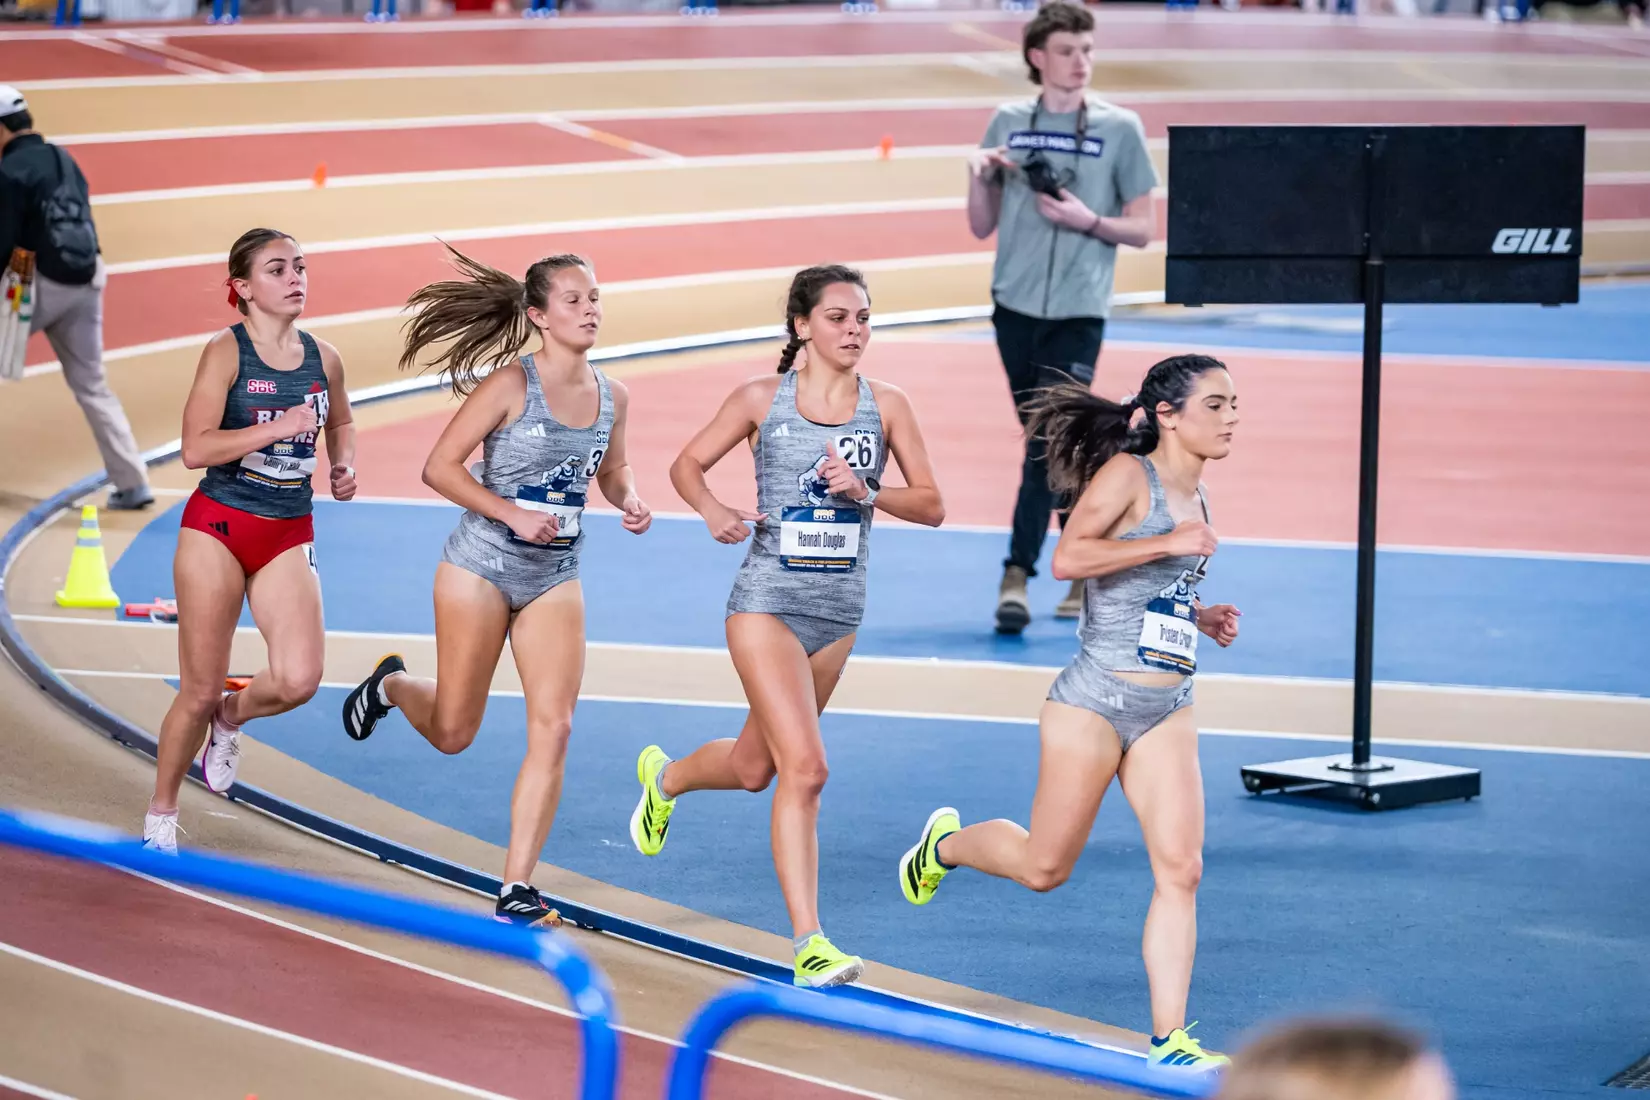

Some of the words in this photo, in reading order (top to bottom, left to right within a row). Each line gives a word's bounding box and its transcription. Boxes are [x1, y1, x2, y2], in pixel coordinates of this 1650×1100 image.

[1491, 228, 1572, 253] GILL
[247, 379, 277, 394] SBC
[273, 443, 294, 455] SBC
[839, 436, 872, 467] 26
[585, 449, 603, 477] 3
[813, 508, 835, 521] SBC
[798, 531, 821, 547] Hannah
[822, 531, 846, 551] Douglas
